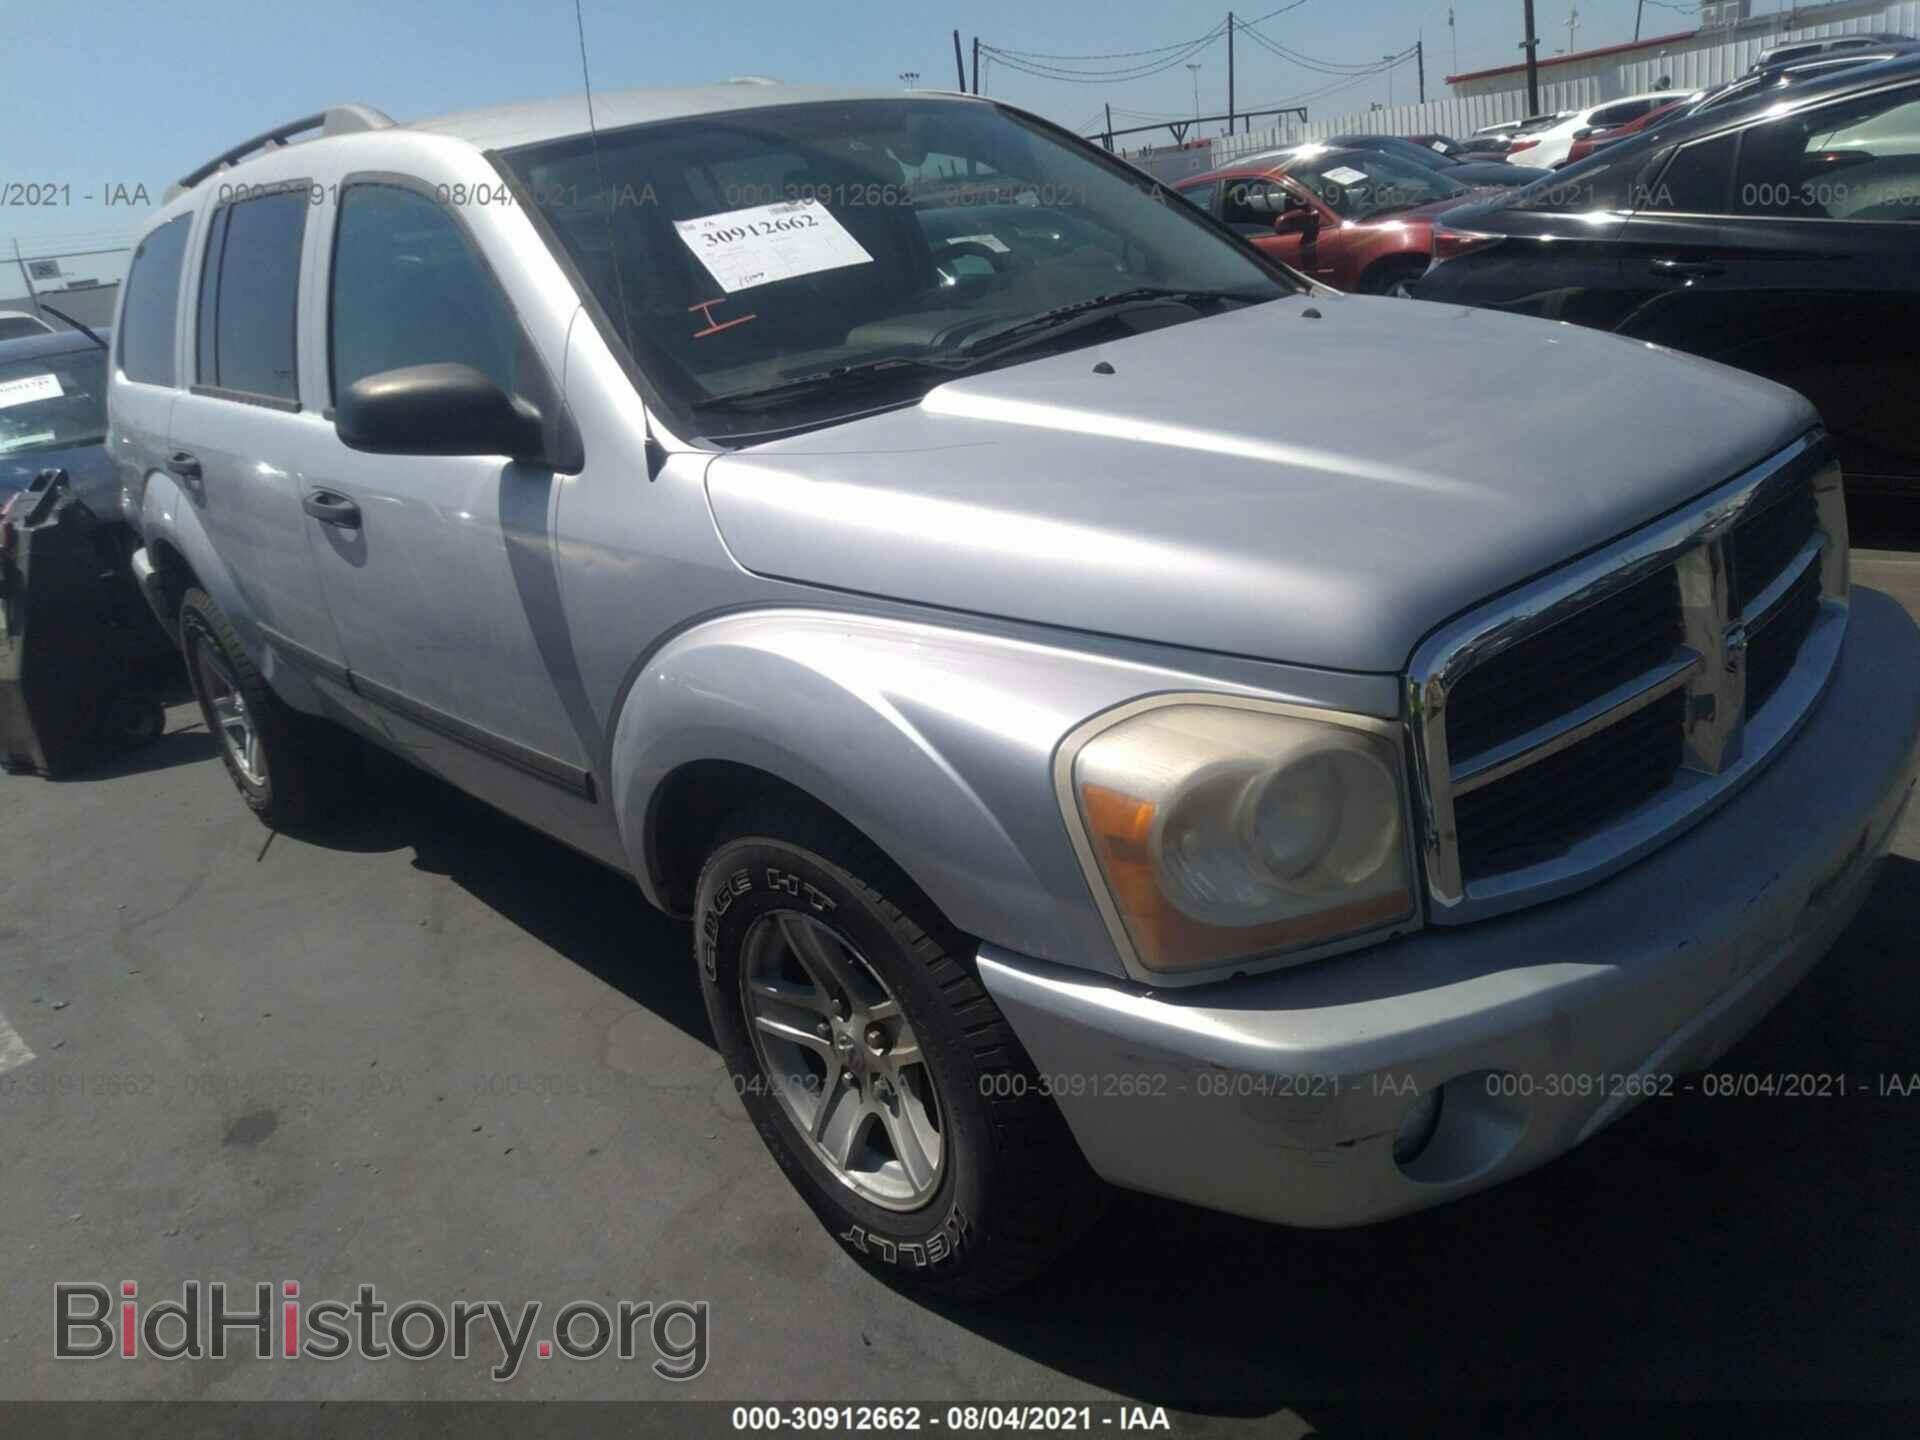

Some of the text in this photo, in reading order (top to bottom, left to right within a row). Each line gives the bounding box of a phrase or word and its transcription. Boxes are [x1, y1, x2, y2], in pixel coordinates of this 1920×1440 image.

[701, 214, 819, 248] 30912662
[703, 867, 838, 982] EDGE HT
[840, 1201, 968, 1267] KELLY
